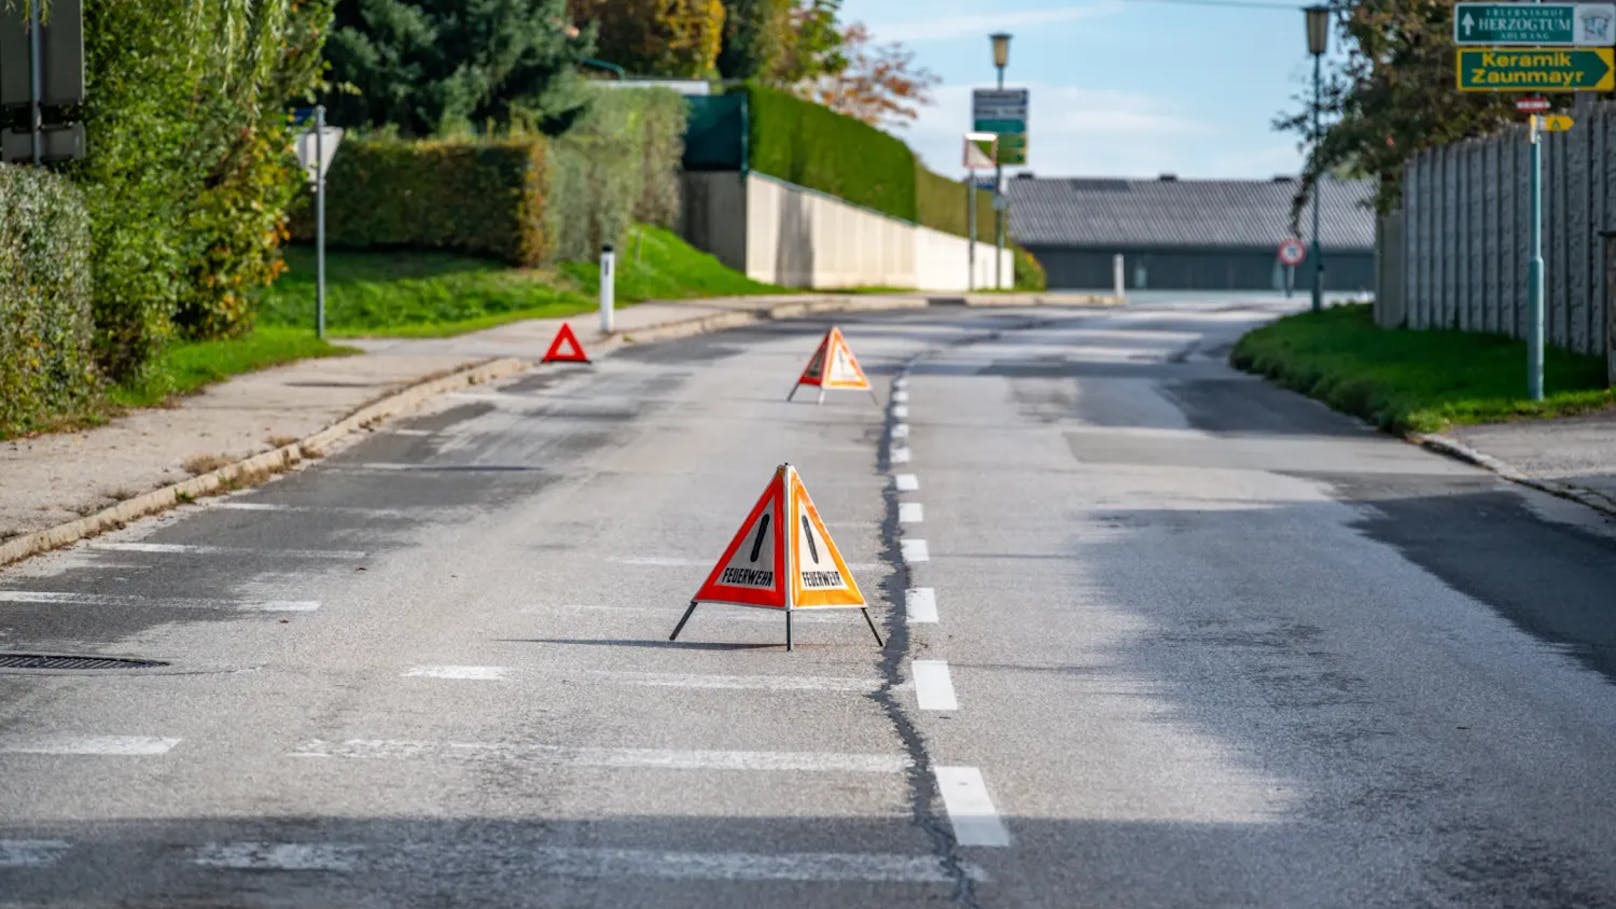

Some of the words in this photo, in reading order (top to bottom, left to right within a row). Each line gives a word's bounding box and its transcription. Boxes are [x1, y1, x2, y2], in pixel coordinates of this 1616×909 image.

[1478, 18, 1571, 31] HERZOGTUM
[1482, 52, 1571, 67] Keramik
[1471, 68, 1584, 87] Zaunmayr
[721, 567, 773, 587] FEUERWEHR
[802, 571, 844, 587] FEUERWEHR
